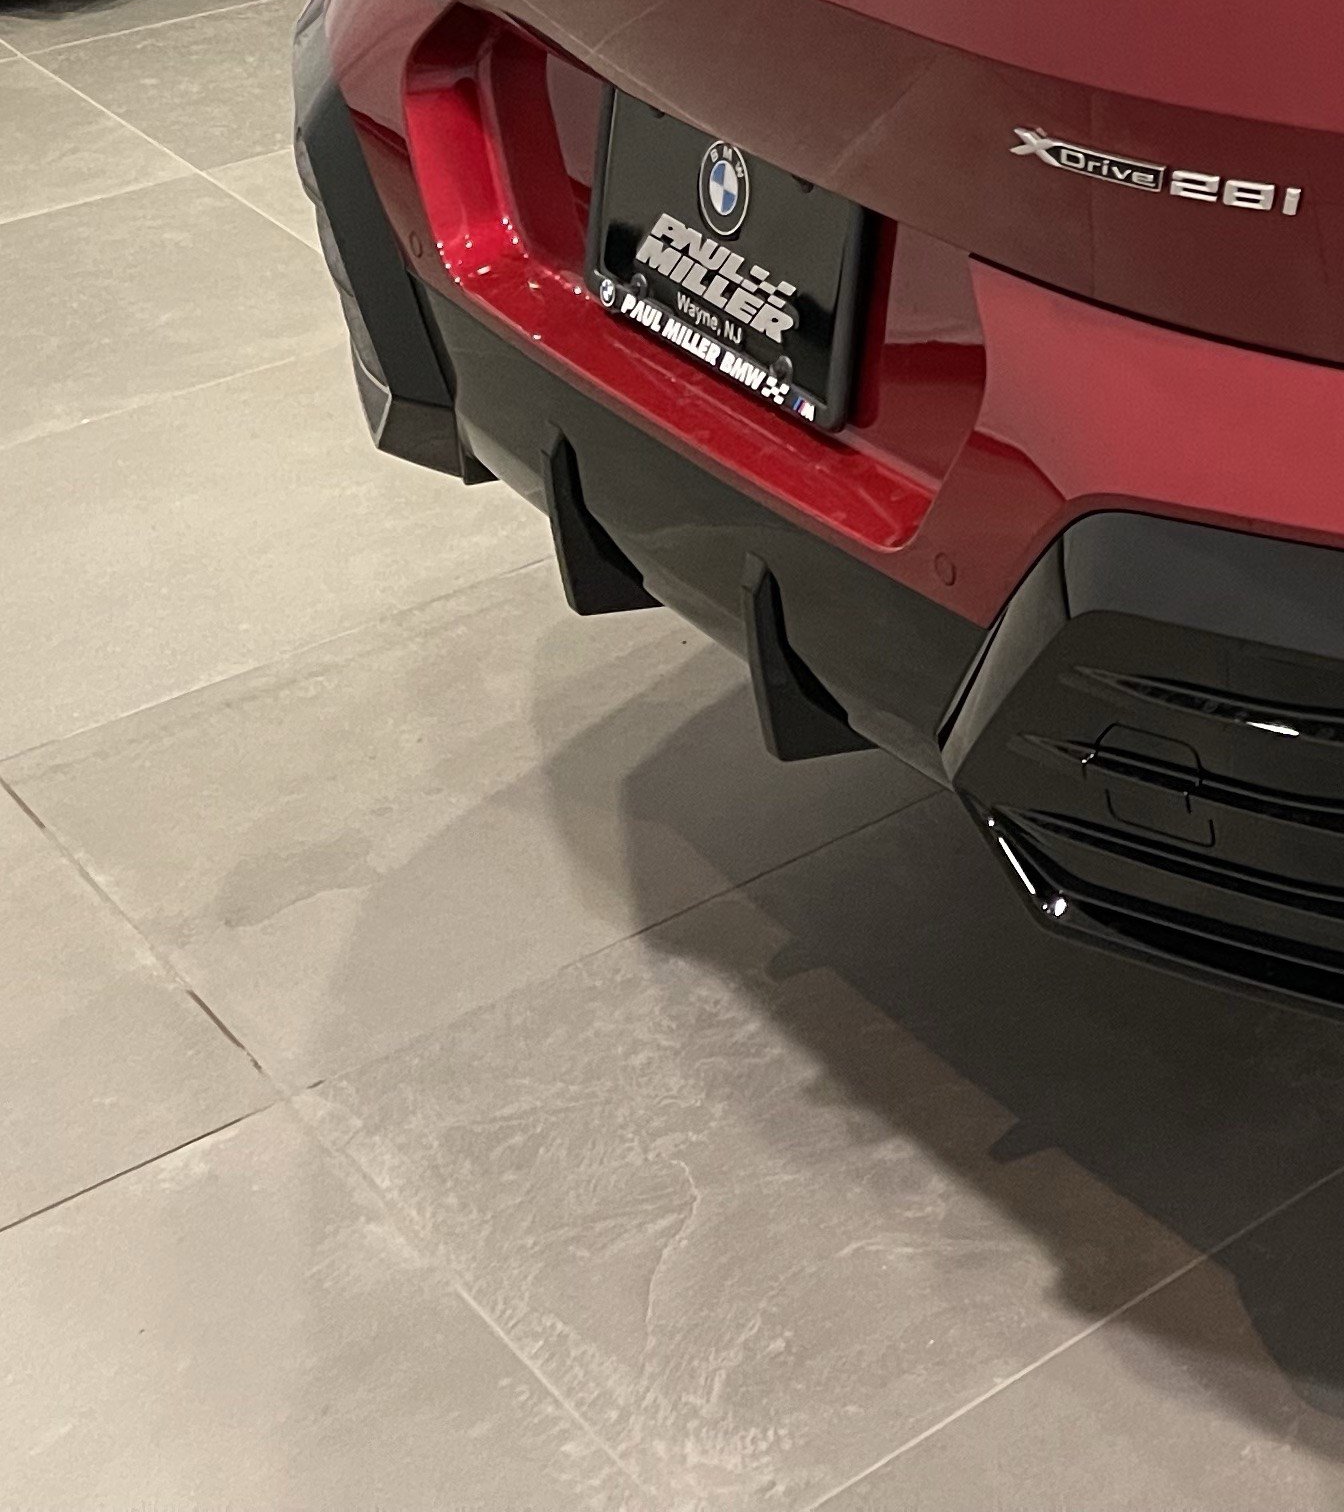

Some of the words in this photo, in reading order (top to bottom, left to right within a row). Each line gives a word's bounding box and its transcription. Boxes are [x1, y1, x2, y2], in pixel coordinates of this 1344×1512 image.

[710, 145, 745, 178] BMW
[651, 212, 745, 285] PAUL
[635, 235, 794, 344] MILLER
[677, 291, 721, 337] Wayne,
[723, 320, 743, 345] NJ
[621, 293, 662, 333] PAUL
[661, 318, 721, 367] MILLER
[720, 351, 767, 390] BMW
